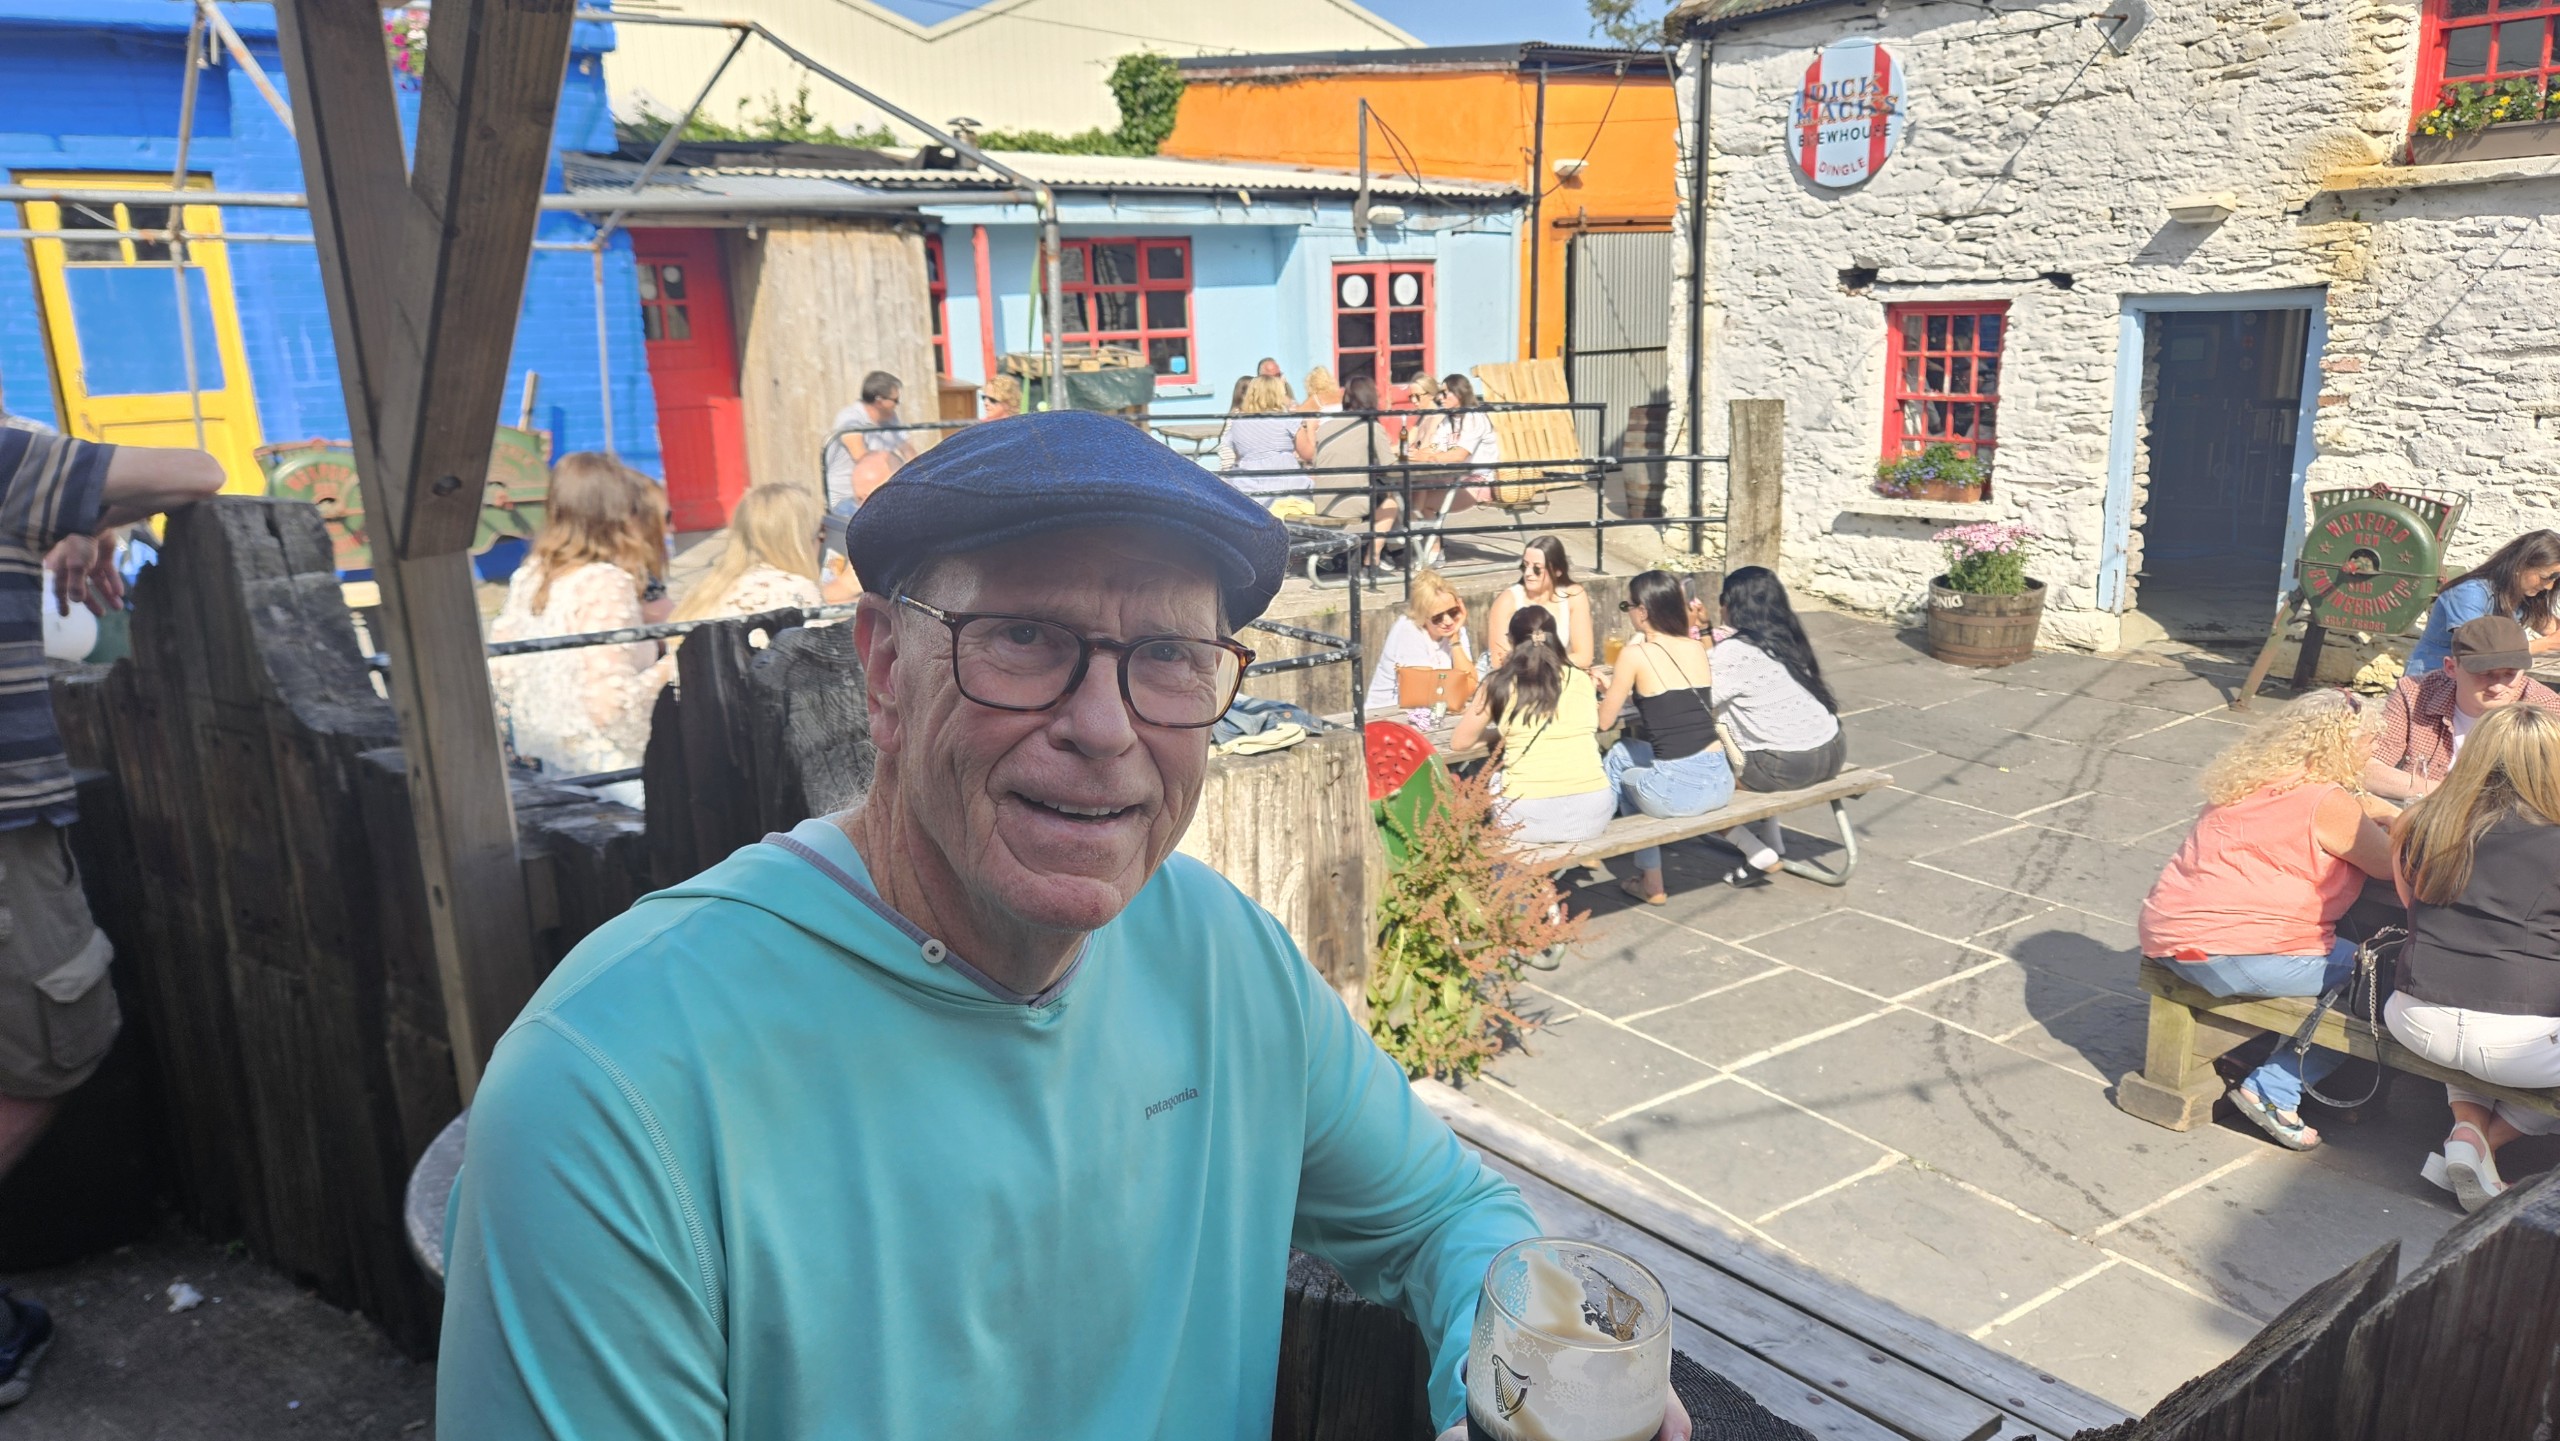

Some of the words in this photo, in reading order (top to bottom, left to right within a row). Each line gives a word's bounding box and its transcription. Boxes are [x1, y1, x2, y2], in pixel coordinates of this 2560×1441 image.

[1810, 72, 1883, 102] DICK
[1798, 124, 1892, 147] BREWHOUSE
[1818, 157, 1866, 177] DINGLE
[2325, 512, 2410, 544] WEXFORD
[2348, 581, 2374, 594] STAR
[1145, 1087, 1199, 1120] patagonia
